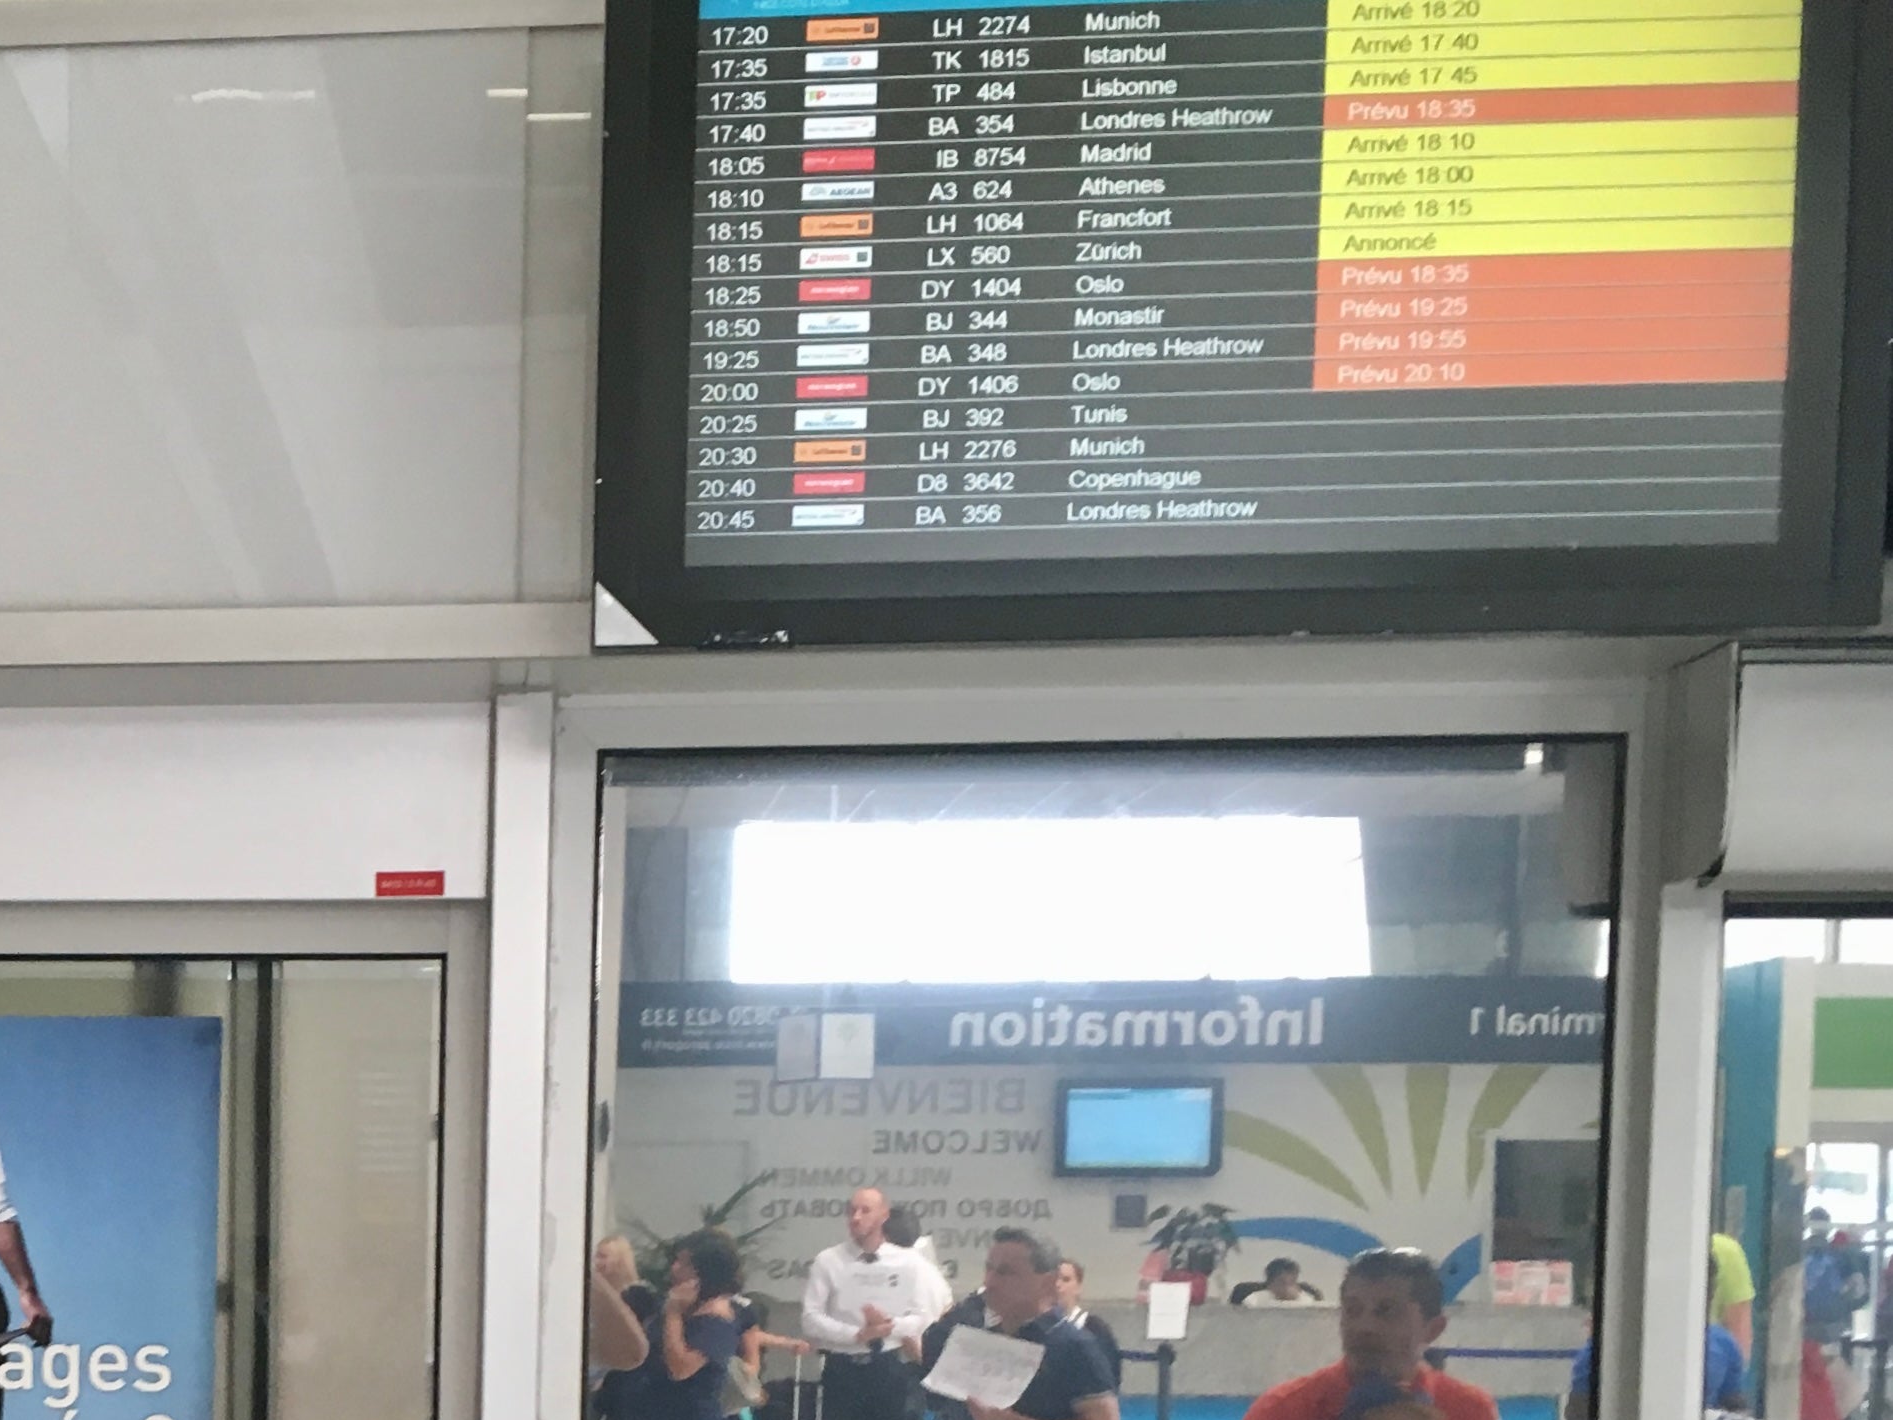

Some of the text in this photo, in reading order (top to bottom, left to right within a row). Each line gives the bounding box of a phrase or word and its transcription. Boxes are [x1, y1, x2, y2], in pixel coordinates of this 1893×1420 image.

[712, 26, 768, 46] 17:20
[933, 18, 962, 38] LH
[979, 15, 1030, 36] 2274
[1085, 11, 1160, 32] Munich
[1352, 0, 1413, 20] Arrivé
[711, 58, 767, 79] 17:35
[932, 51, 962, 70] TK
[979, 48, 1030, 68] 1815
[1084, 43, 1166, 64] Istanbul
[1351, 34, 1412, 53] Arrivé
[710, 91, 766, 111] 17:35
[932, 84, 961, 103] TP
[976, 82, 1015, 101] 484
[1082, 78, 1177, 98] Lisbonne
[1350, 68, 1411, 87] Arrivé
[710, 124, 766, 144] 17:40
[928, 117, 959, 136] BA
[975, 114, 1014, 134] 354
[1080, 111, 1166, 131] Londres
[1172, 107, 1273, 127] Heathrow
[1349, 102, 1408, 120] Prévu
[709, 156, 765, 176] 18:05
[936, 149, 959, 168] IB
[974, 147, 1026, 167] 8754
[1080, 142, 1151, 163] Madrid
[1347, 134, 1408, 153] Arrivé
[708, 189, 764, 208] 18:10
[928, 182, 958, 201] A3
[973, 180, 1012, 200] 624
[1079, 177, 1165, 196] Athenes
[1347, 168, 1407, 186] Arrivé
[707, 221, 763, 241] 18:15
[927, 215, 956, 234] LH
[974, 212, 1024, 232] 1064
[1077, 209, 1172, 229] Francfort
[1345, 201, 1405, 219] Arrivé
[706, 253, 762, 273] 18:15
[927, 247, 955, 267] LX
[971, 245, 1010, 265] 560
[1076, 242, 1141, 262] Zürich
[1343, 232, 1436, 252] Annoncé
[705, 286, 761, 305] 18:25
[921, 280, 954, 300] DY
[971, 278, 1021, 298] 1404
[1076, 275, 1124, 294] Oslo
[1342, 267, 1401, 285] Prévu
[704, 318, 760, 337] 18:50
[926, 312, 953, 332] BJ
[969, 310, 1007, 330] 344
[1074, 306, 1165, 327] Monastir
[1341, 299, 1400, 317] Prévu
[703, 351, 759, 370] 19:25
[921, 345, 952, 364] BA
[968, 343, 1007, 362] 348
[1073, 340, 1157, 359] Londres
[1163, 337, 1264, 356] Heathrow
[1340, 332, 1399, 350] Prévu
[701, 383, 758, 402] 20:00
[918, 377, 951, 396] DY
[969, 375, 1019, 394] 1406
[1072, 373, 1120, 391] Oslo
[1339, 365, 1397, 383] Prévu
[700, 405, 1128, 434] 20:25 BJ 392 Tunis
[699, 436, 1145, 466] 20:30 LH 2276 Munich
[698, 478, 755, 498] 20:40
[918, 473, 948, 493] D8
[964, 472, 1014, 491] 3642
[1068, 468, 1201, 490] Copenhague
[698, 500, 1258, 529] 20:45 BA 356 Londres Heathrow
